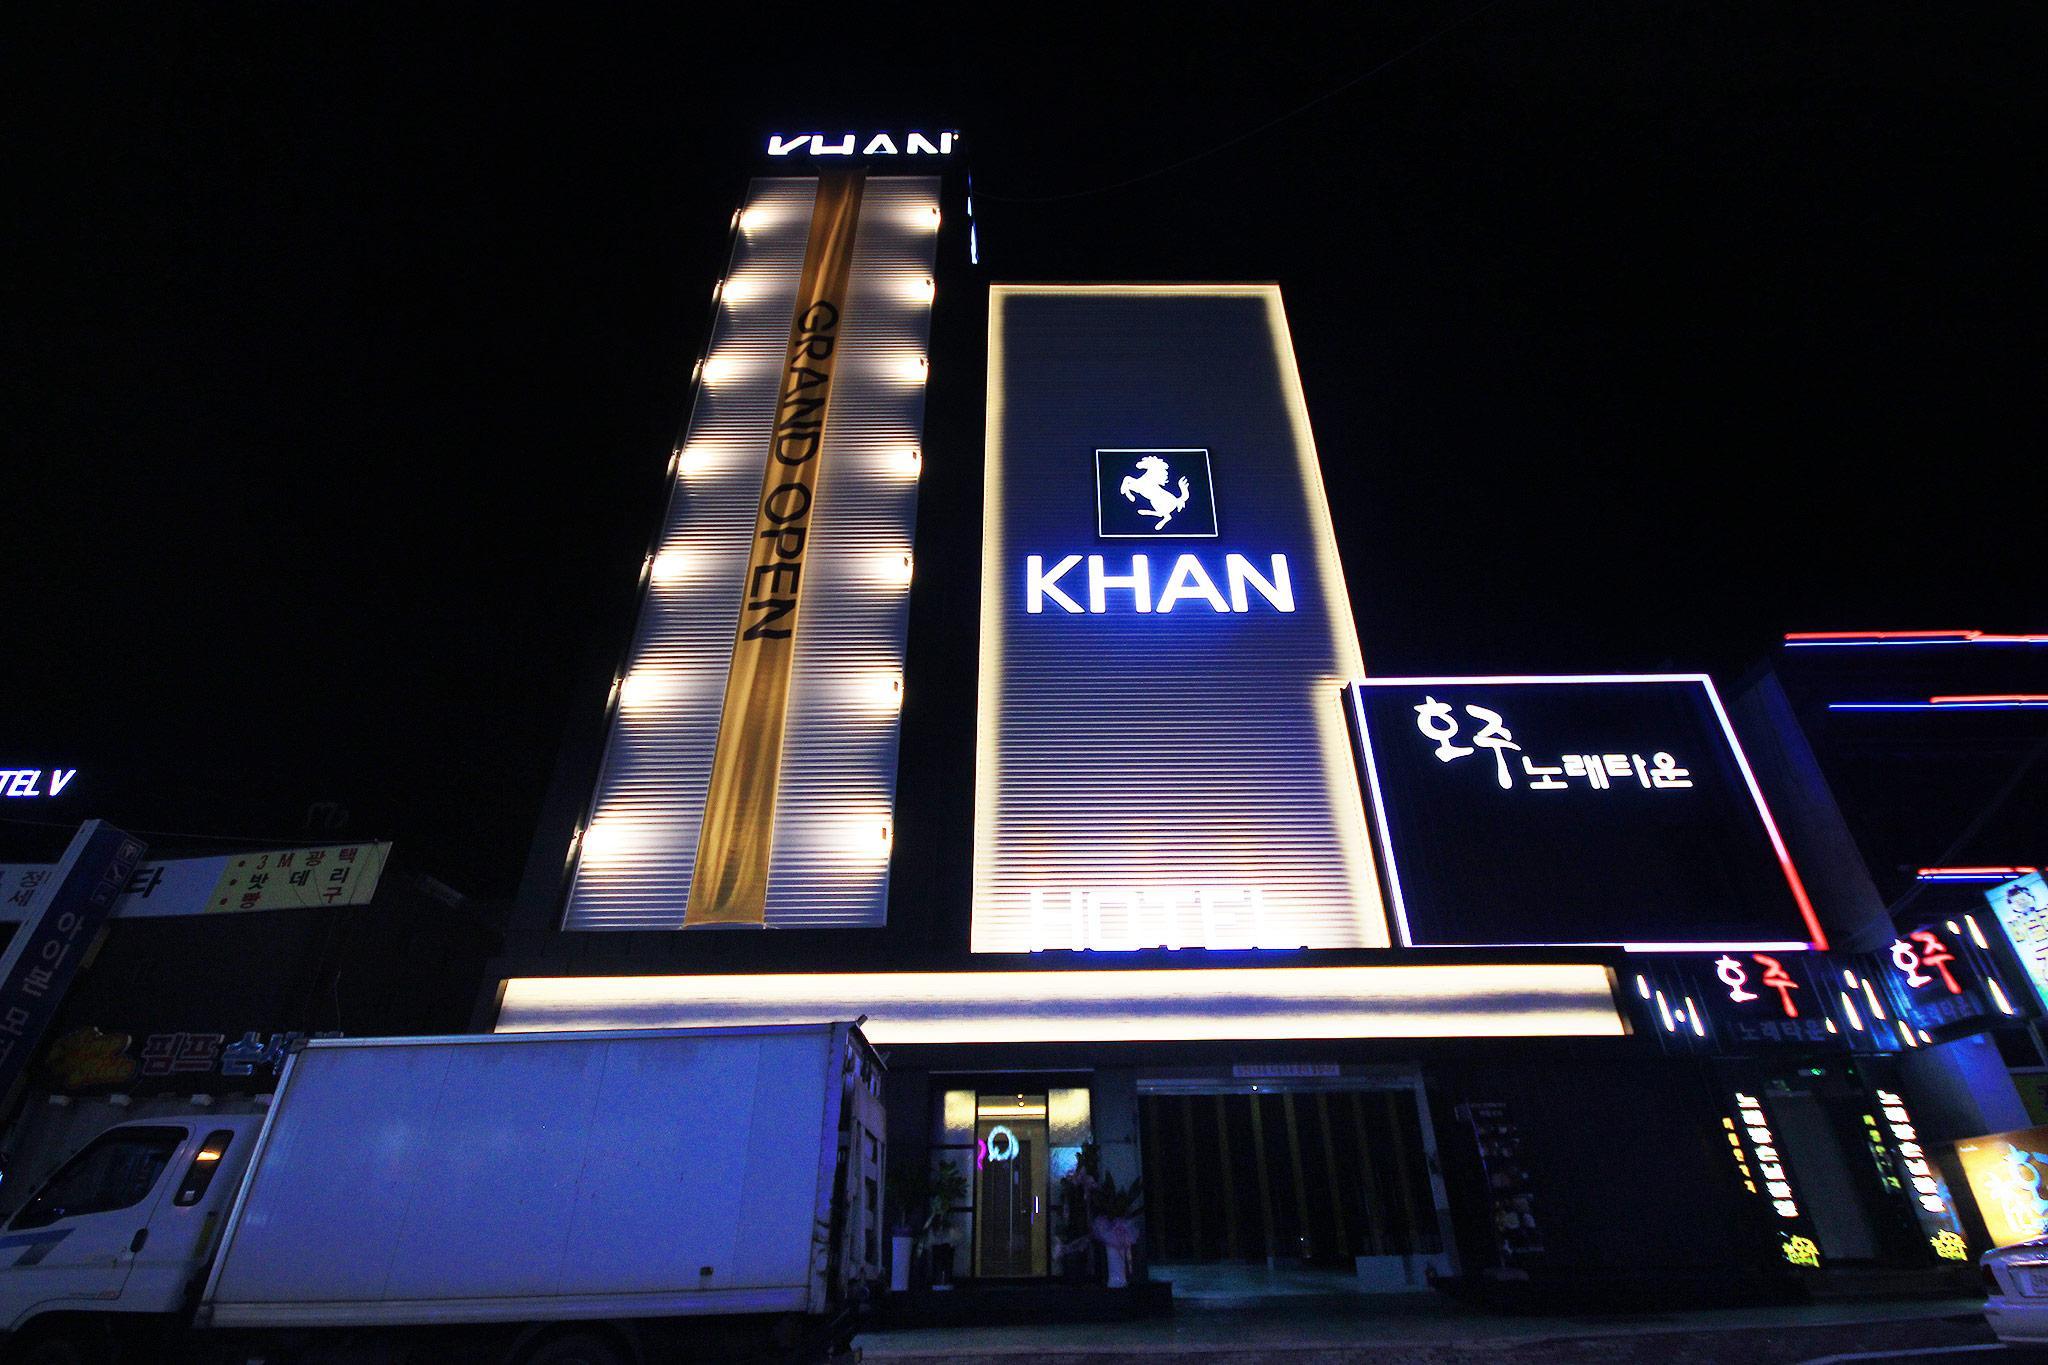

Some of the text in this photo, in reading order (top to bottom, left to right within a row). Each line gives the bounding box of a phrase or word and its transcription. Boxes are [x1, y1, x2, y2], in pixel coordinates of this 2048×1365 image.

[742, 300, 839, 642] GRAND OPEN
[1026, 553, 1296, 614] KHAN
[1413, 695, 1522, 789] 호주
[1521, 751, 1694, 790] 노래타운
[49, 769, 77, 797] V
